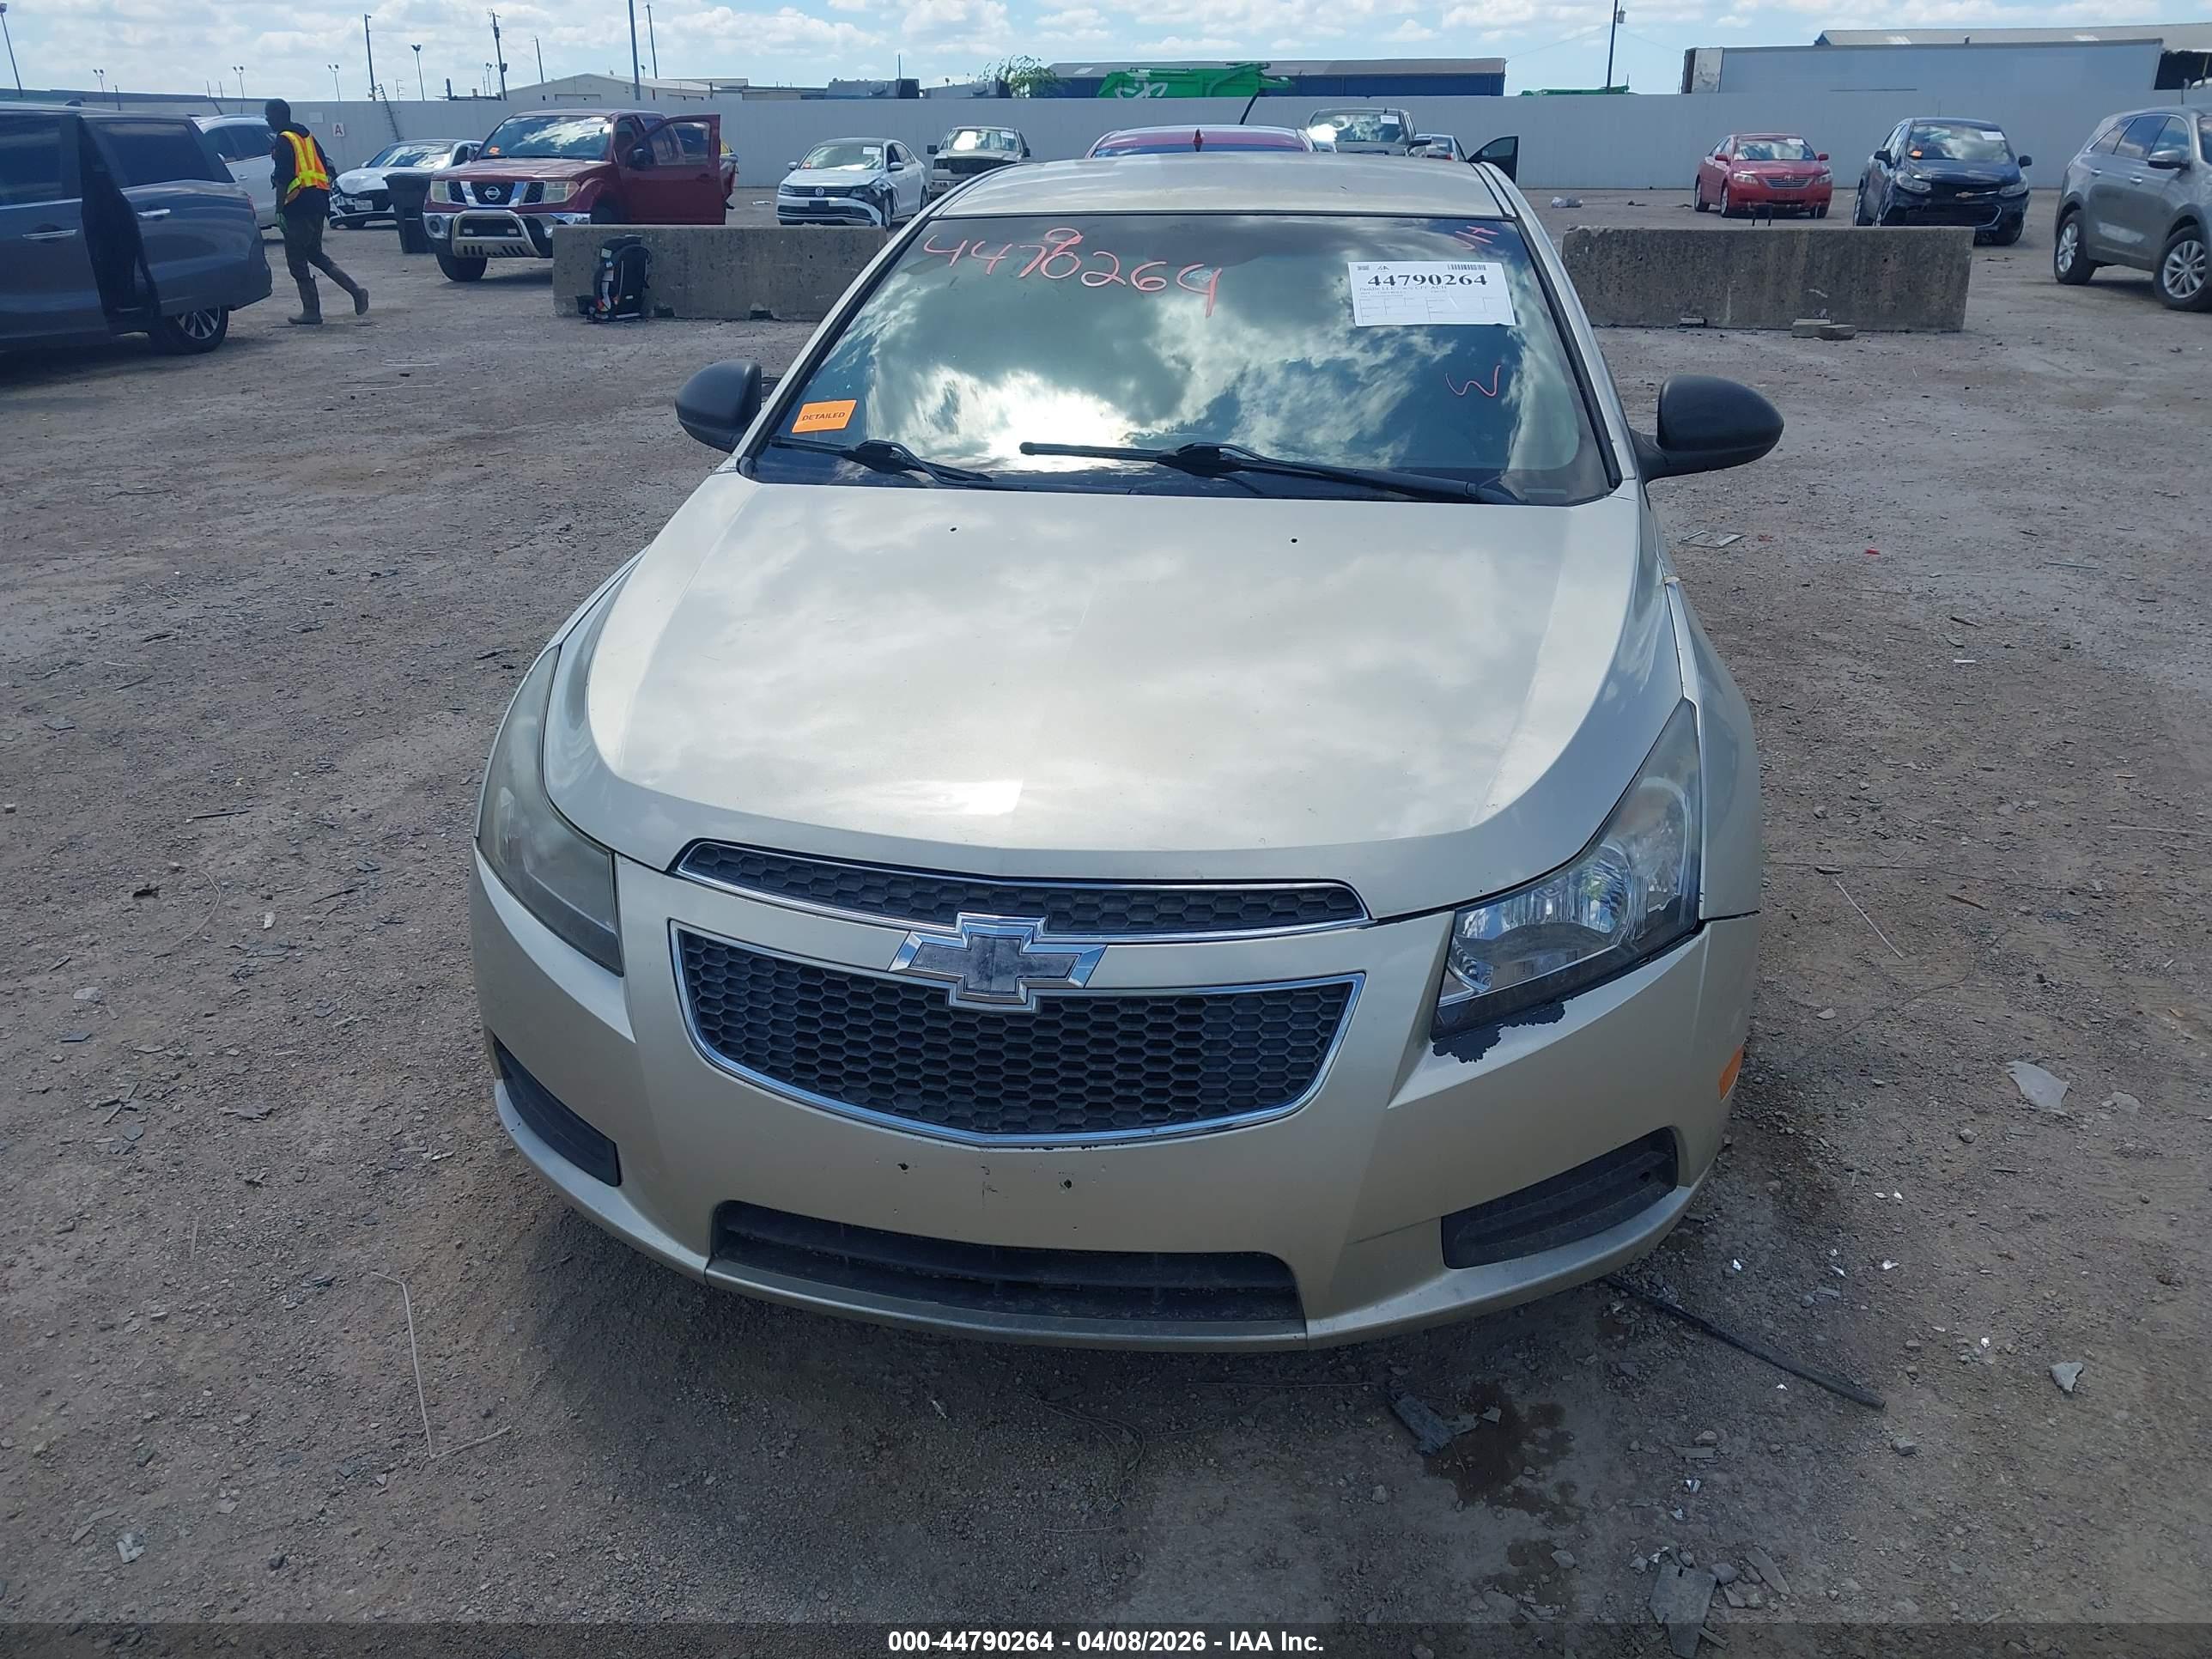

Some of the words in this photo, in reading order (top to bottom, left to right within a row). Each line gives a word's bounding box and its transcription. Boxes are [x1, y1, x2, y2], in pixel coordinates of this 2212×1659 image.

[335, 124, 343, 136] A
[1367, 274, 1488, 287] 44790264
[802, 412, 845, 421] DETAILED
